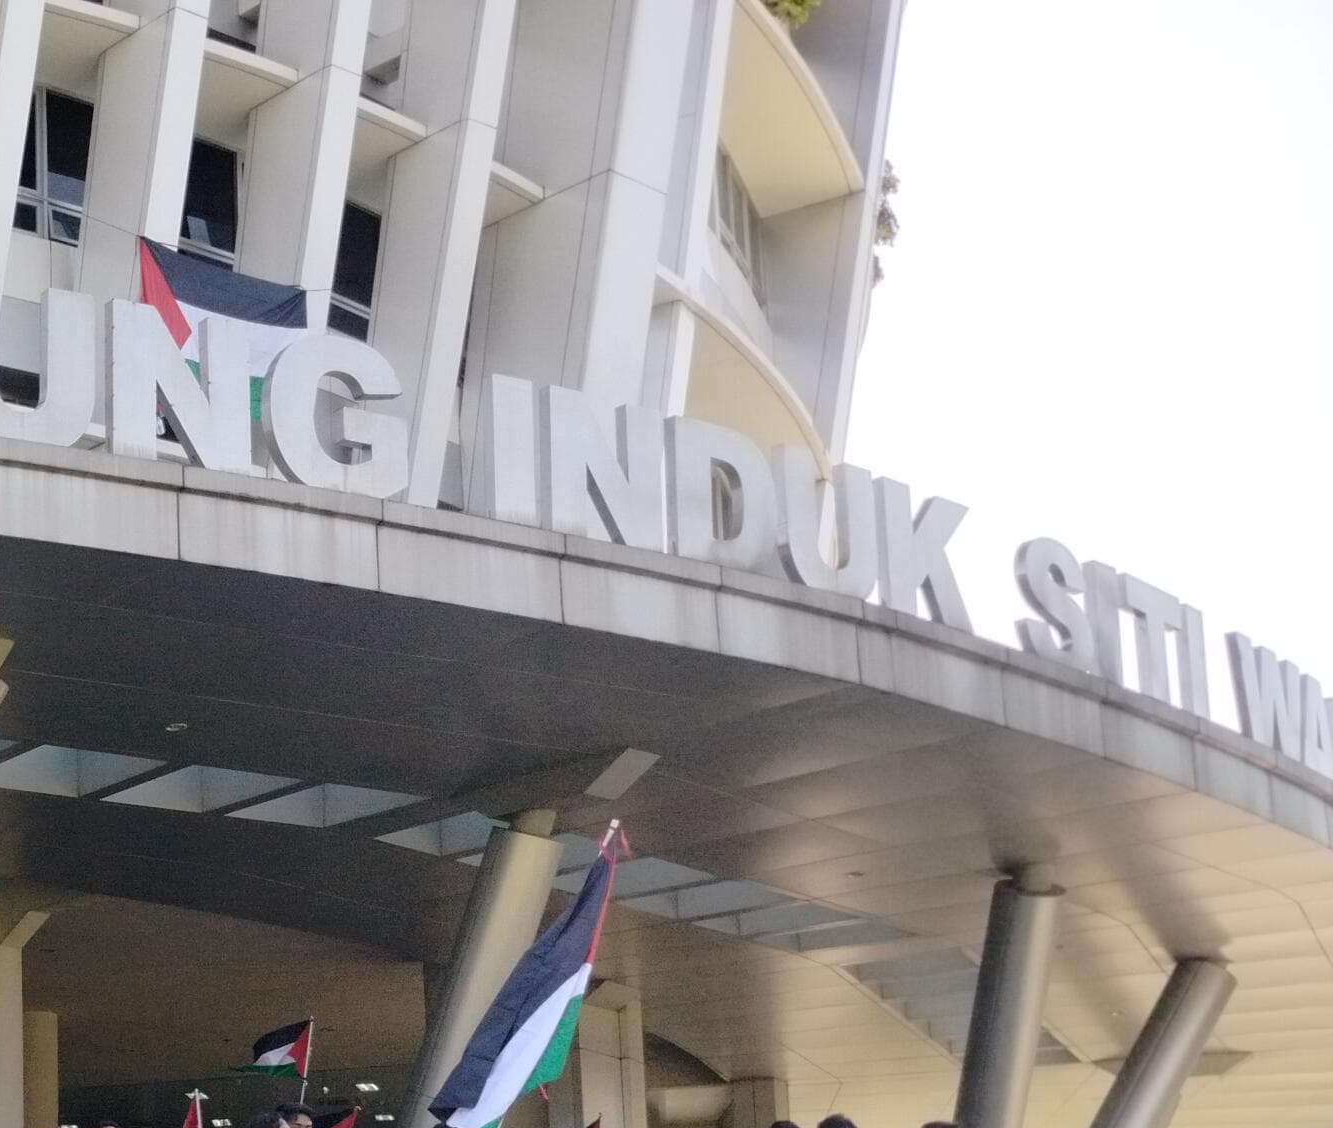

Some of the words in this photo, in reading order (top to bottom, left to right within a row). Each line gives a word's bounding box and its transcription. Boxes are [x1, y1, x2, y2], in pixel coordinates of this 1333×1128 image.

[491, 373, 975, 636] INDUK
[1014, 537, 1211, 721] SITI
[1225, 631, 1333, 780] WA
